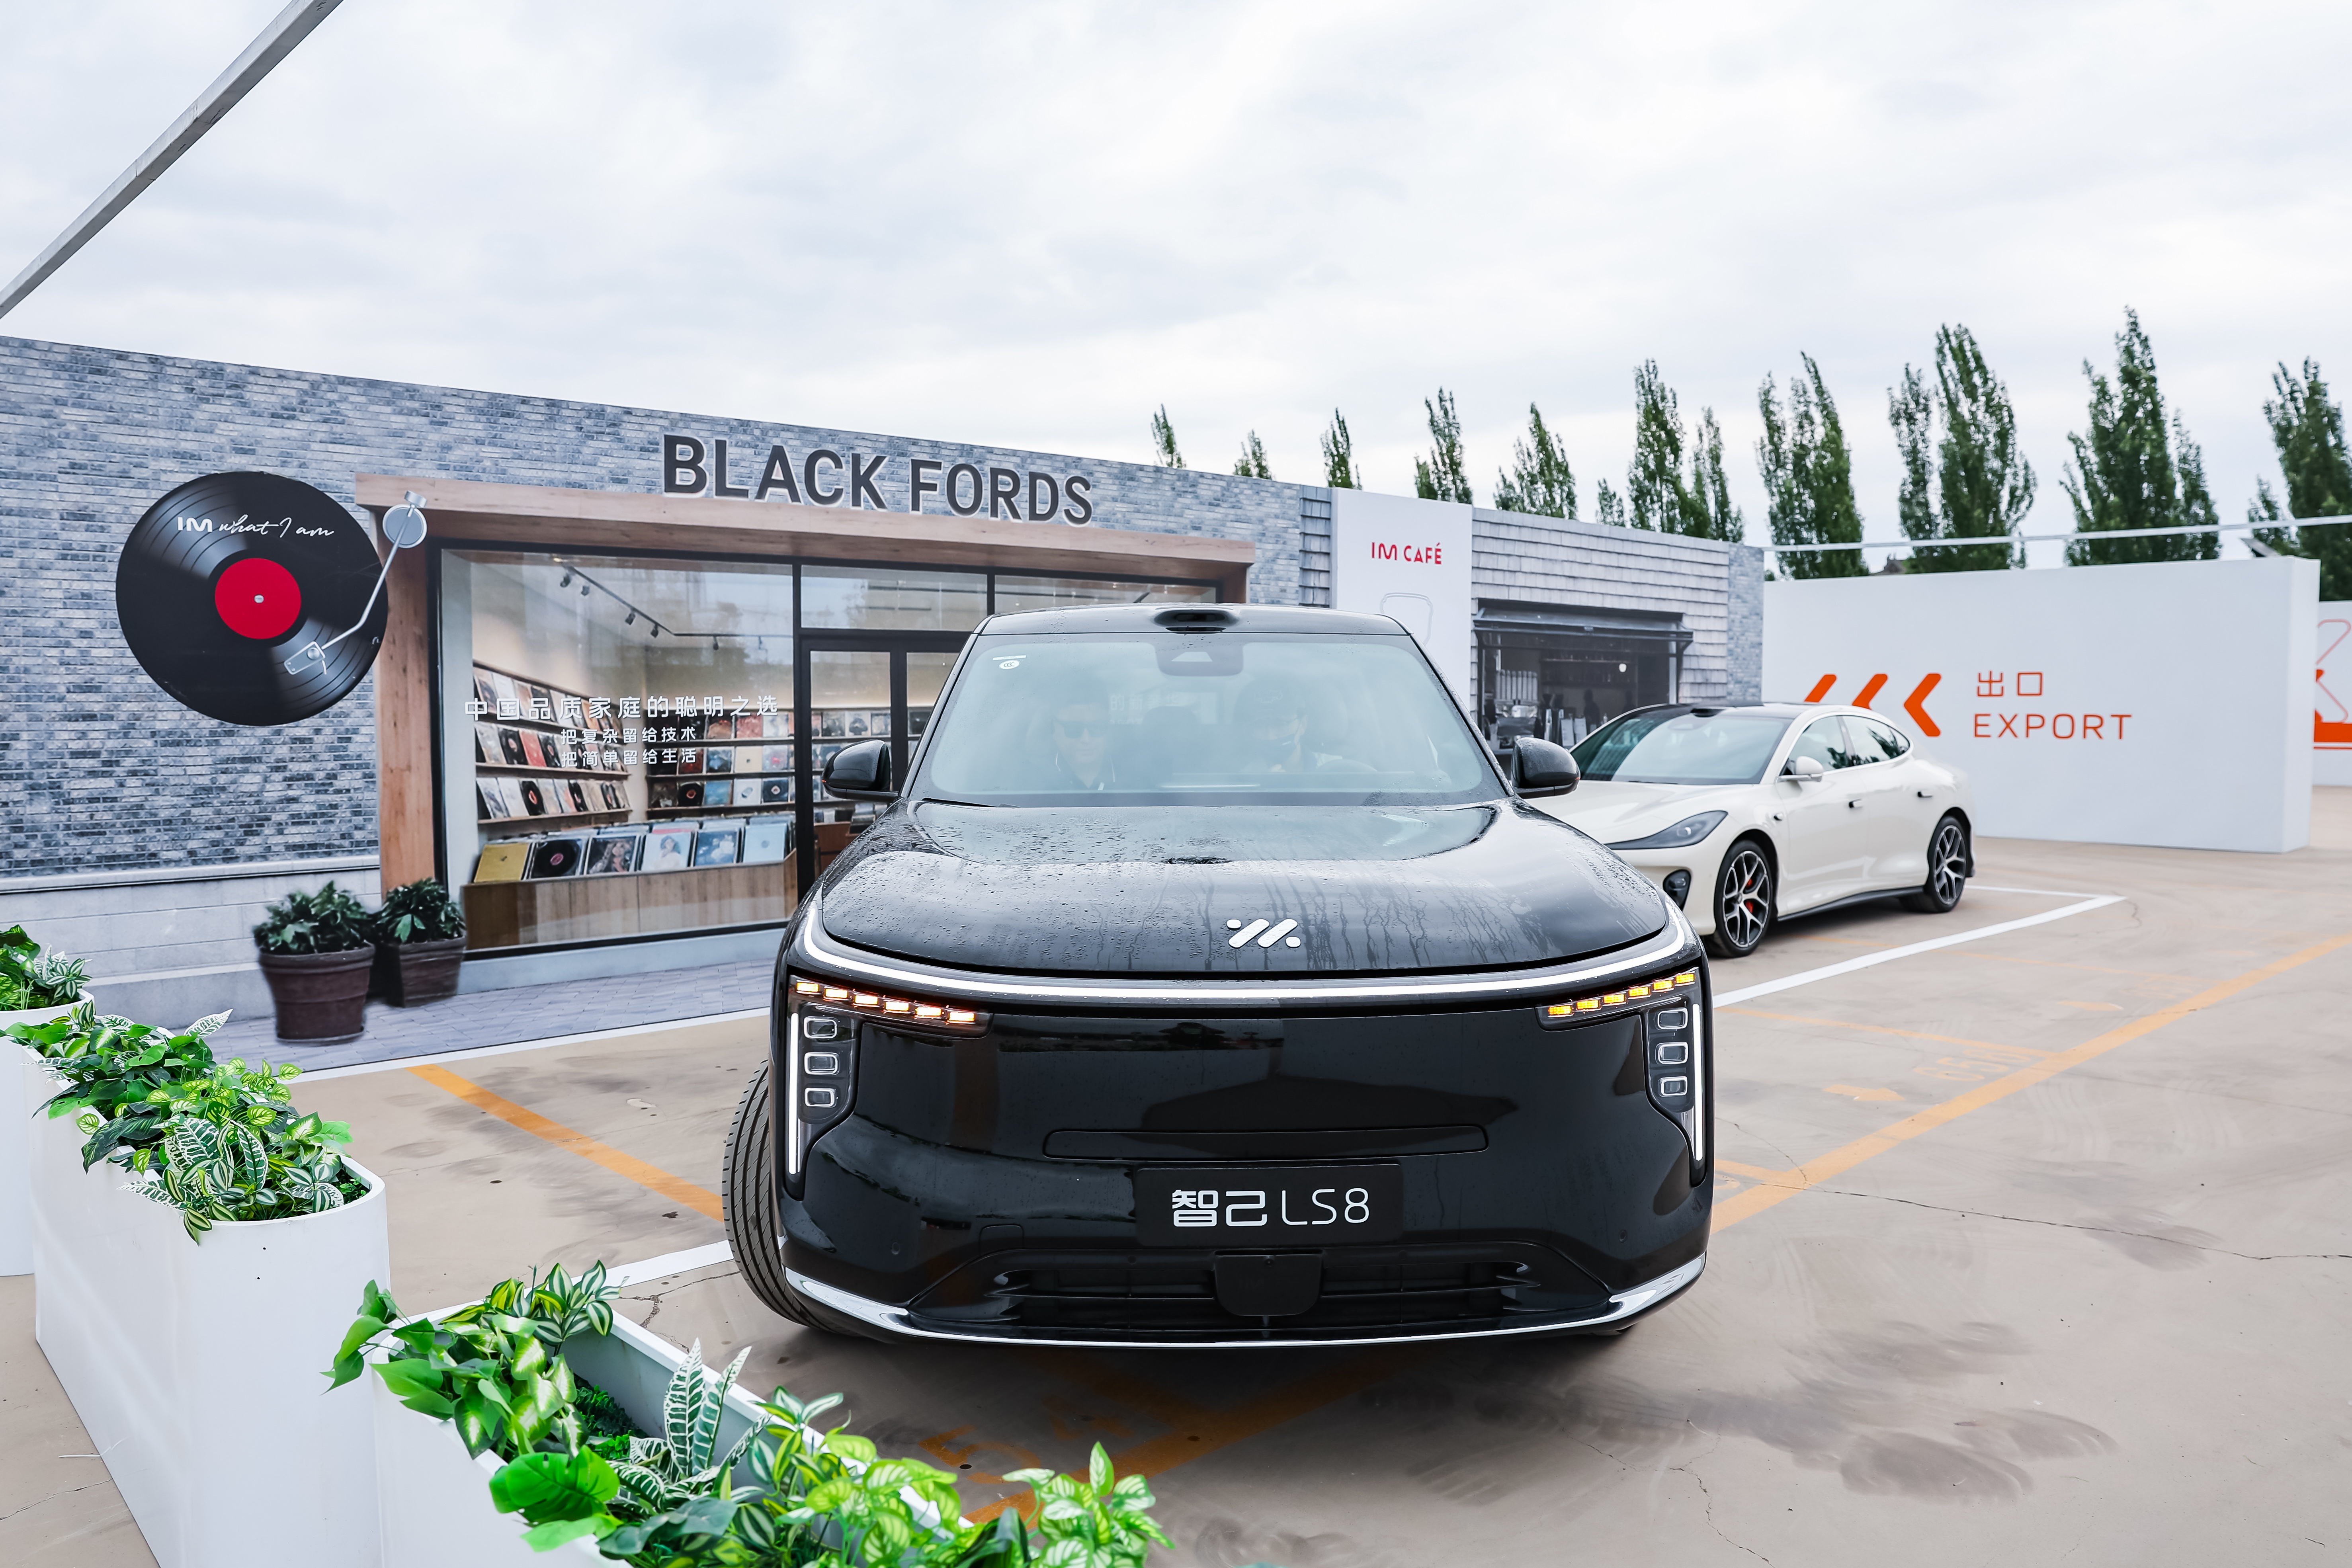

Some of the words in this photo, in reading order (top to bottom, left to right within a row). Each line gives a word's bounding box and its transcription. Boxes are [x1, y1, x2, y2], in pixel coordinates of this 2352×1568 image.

[664, 434, 888, 509] BLACK
[910, 459, 1093, 525] FORDS
[178, 517, 213, 532] IM
[219, 514, 279, 535] what
[296, 526, 334, 537] am
[1371, 541, 1398, 561] IM
[1403, 542, 1442, 565] CAFÉ
[1977, 670, 2043, 697] 出口
[465, 695, 778, 721] 中国品质家庭的聪明之选
[561, 726, 696, 745] 把复杂留给技术
[1974, 713, 2132, 740] EXPORT
[561, 748, 696, 767] 把简单留给生活
[1172, 1189, 1268, 1227] 智己
[1281, 1188, 1369, 1225] LS8
